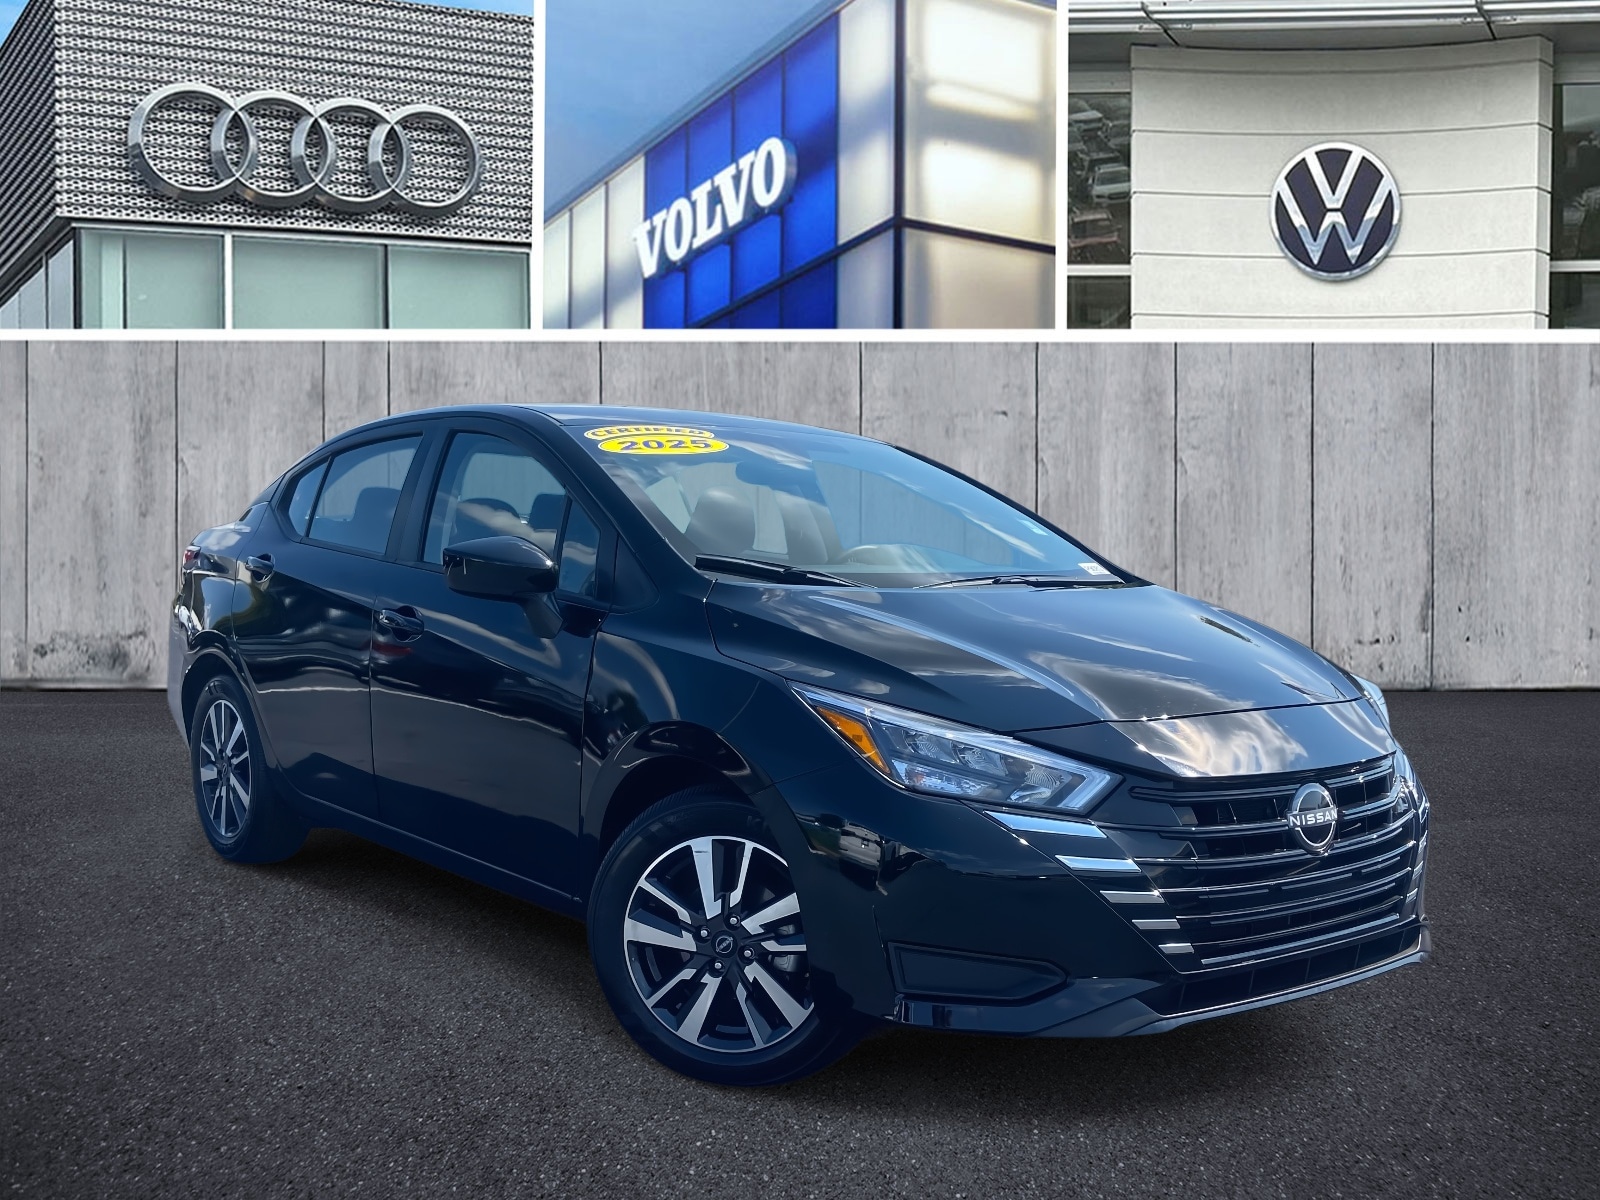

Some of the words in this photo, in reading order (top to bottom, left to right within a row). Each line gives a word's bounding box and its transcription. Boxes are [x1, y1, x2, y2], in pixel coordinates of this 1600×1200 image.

[633, 137, 787, 279] VOLVO
[590, 426, 705, 437] CERTIFIED
[617, 439, 713, 451] 2025
[1289, 807, 1338, 826] NISSAN
